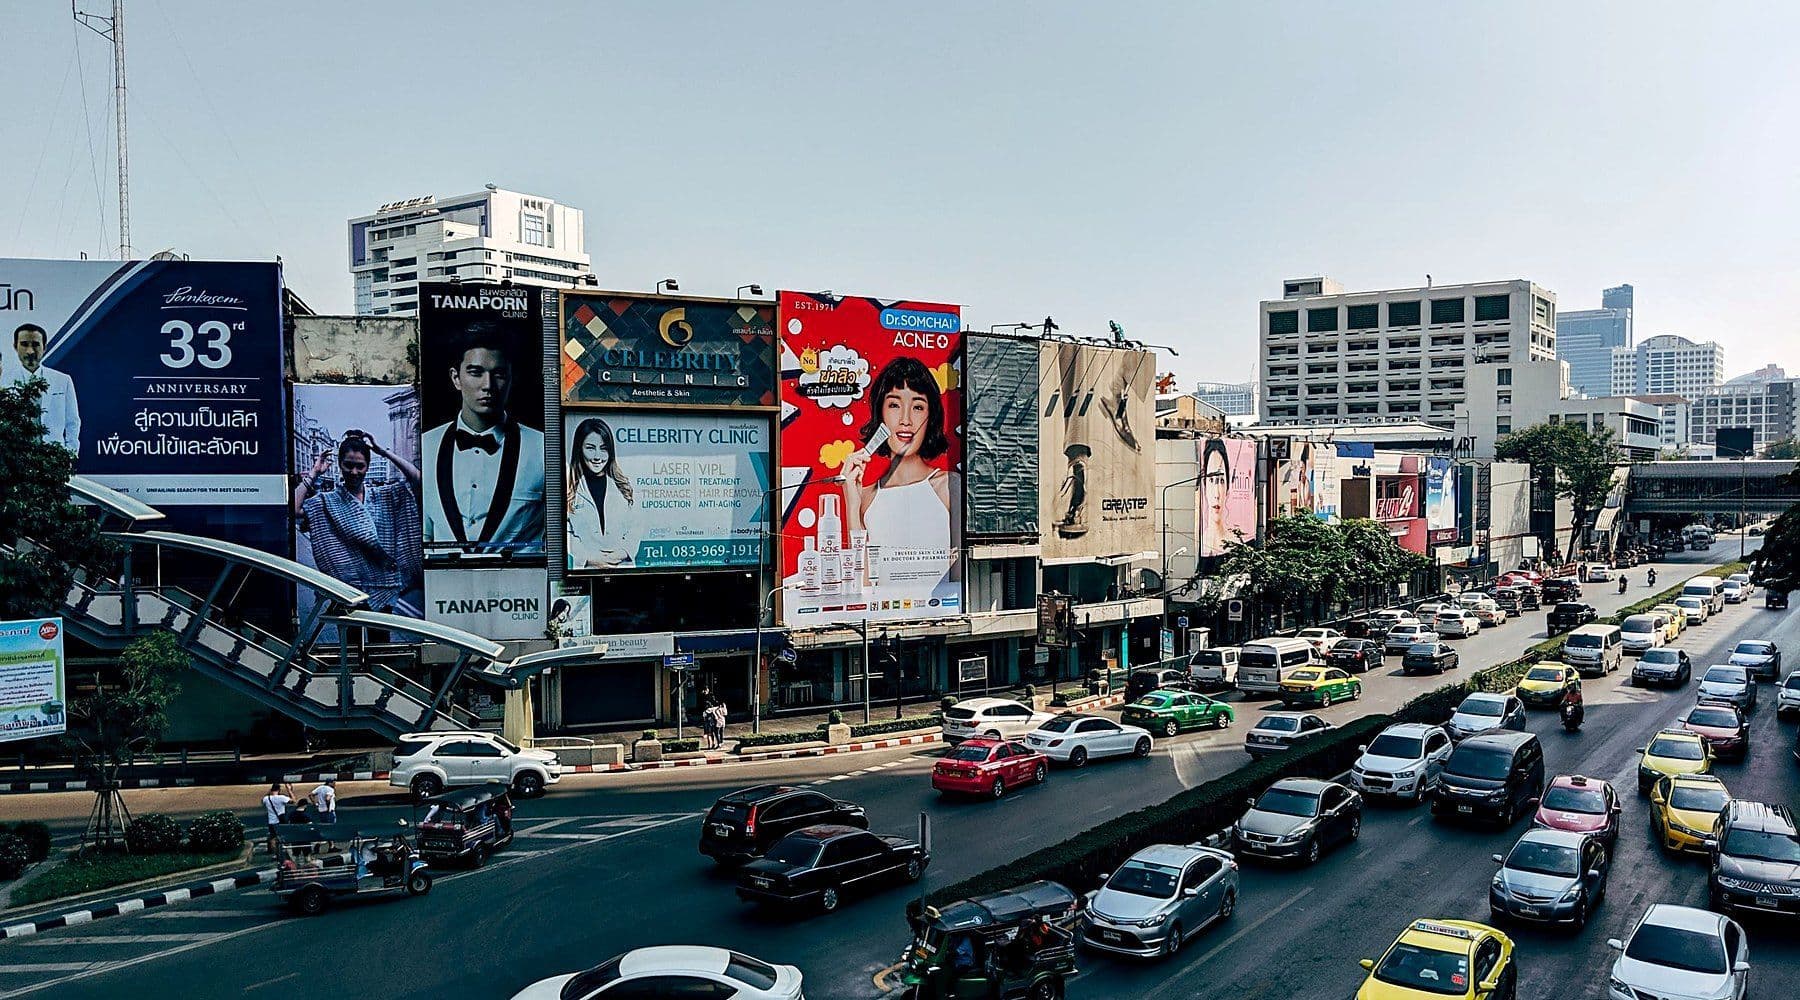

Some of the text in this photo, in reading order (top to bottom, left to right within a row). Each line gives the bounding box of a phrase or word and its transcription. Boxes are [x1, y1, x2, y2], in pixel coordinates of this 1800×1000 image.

[431, 295, 528, 310] TANAPORN
[795, 301, 834, 312] EST.1971
[502, 310, 528, 318] CLINIC
[893, 332, 934, 348] ACNE
[604, 348, 738, 371] CELEBRITY
[602, 371, 746, 387] CLINIC
[147, 384, 247, 394] ANNIVERSARY
[632, 389, 666, 397] Aesthetic
[135, 406, 258, 432] สู่ความเป็นเลิศ
[615, 428, 758, 445] CELEBRITY CLINIC
[97, 433, 258, 456] เพื่อคนไข้และสังคม
[652, 462, 690, 475] LASER
[698, 463, 725, 476] VIPL
[637, 478, 690, 486] FACIAL DESIGN
[699, 478, 740, 486] TREATMENT
[642, 488, 690, 499] THERMAGE
[699, 488, 762, 498] HAIR REMOVAL
[642, 500, 691, 509] LIPOSUCTION
[698, 500, 741, 509] ANTI-AGING
[644, 544, 761, 558] Tel. 083-969-1914
[435, 598, 539, 614] TANAPORN
[511, 612, 539, 621] CLINIC
[619, 638, 648, 648] beauty
